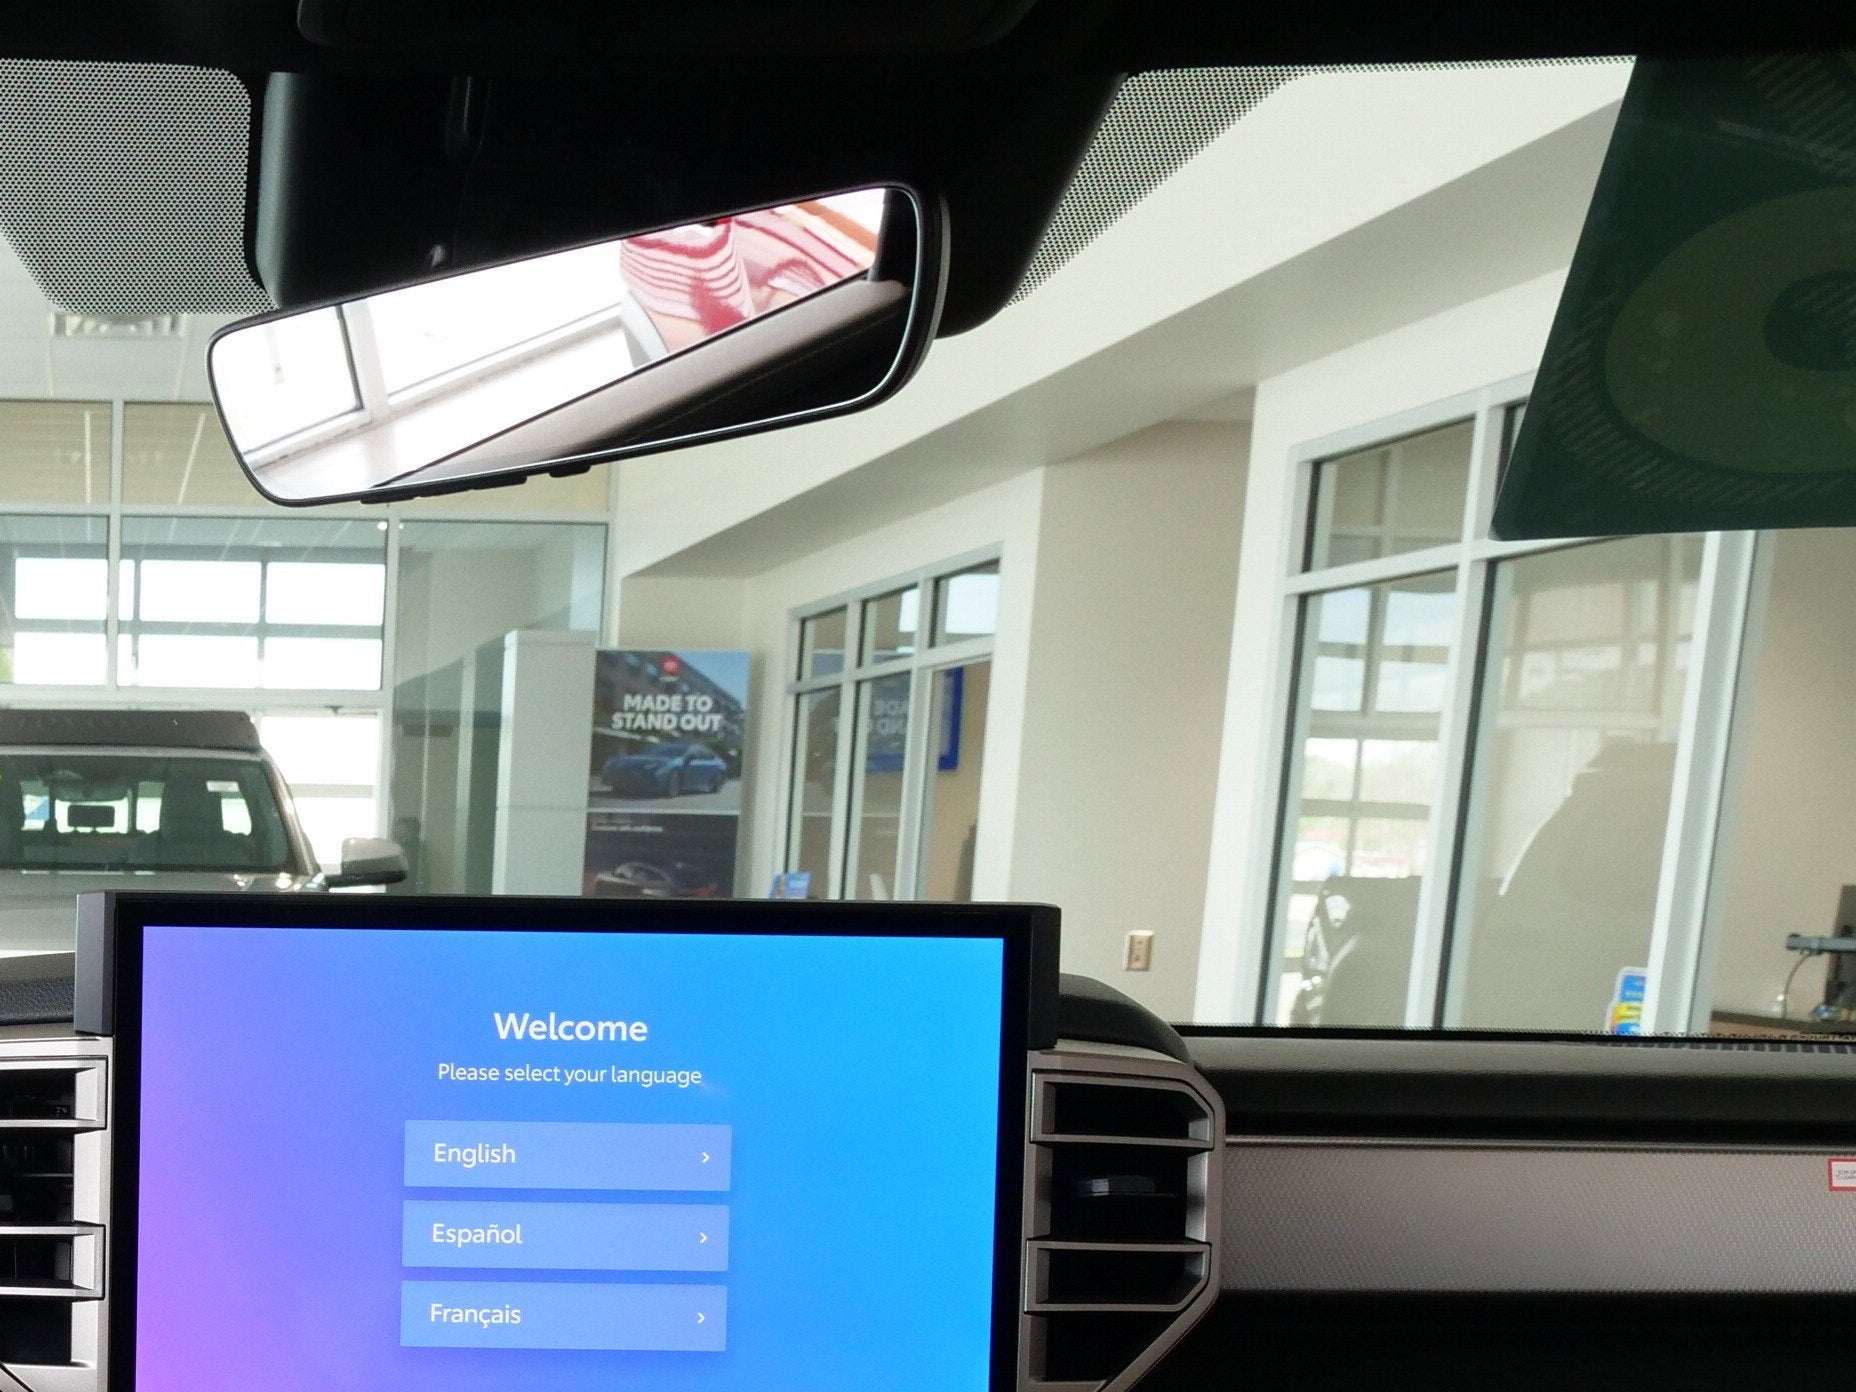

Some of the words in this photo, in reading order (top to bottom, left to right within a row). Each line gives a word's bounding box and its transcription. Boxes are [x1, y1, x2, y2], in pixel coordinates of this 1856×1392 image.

[623, 694, 682, 712] MADE
[686, 694, 713, 712] TO
[611, 712, 677, 731] STAND
[680, 713, 724, 732] OUT
[493, 1012, 649, 1042] Welcome
[437, 1063, 500, 1082] Please
[504, 1063, 561, 1083] select
[564, 1068, 607, 1086] your
[611, 1066, 702, 1088] language
[433, 1143, 516, 1168] English
[431, 1223, 523, 1247] Español
[429, 1304, 522, 1328] Français
